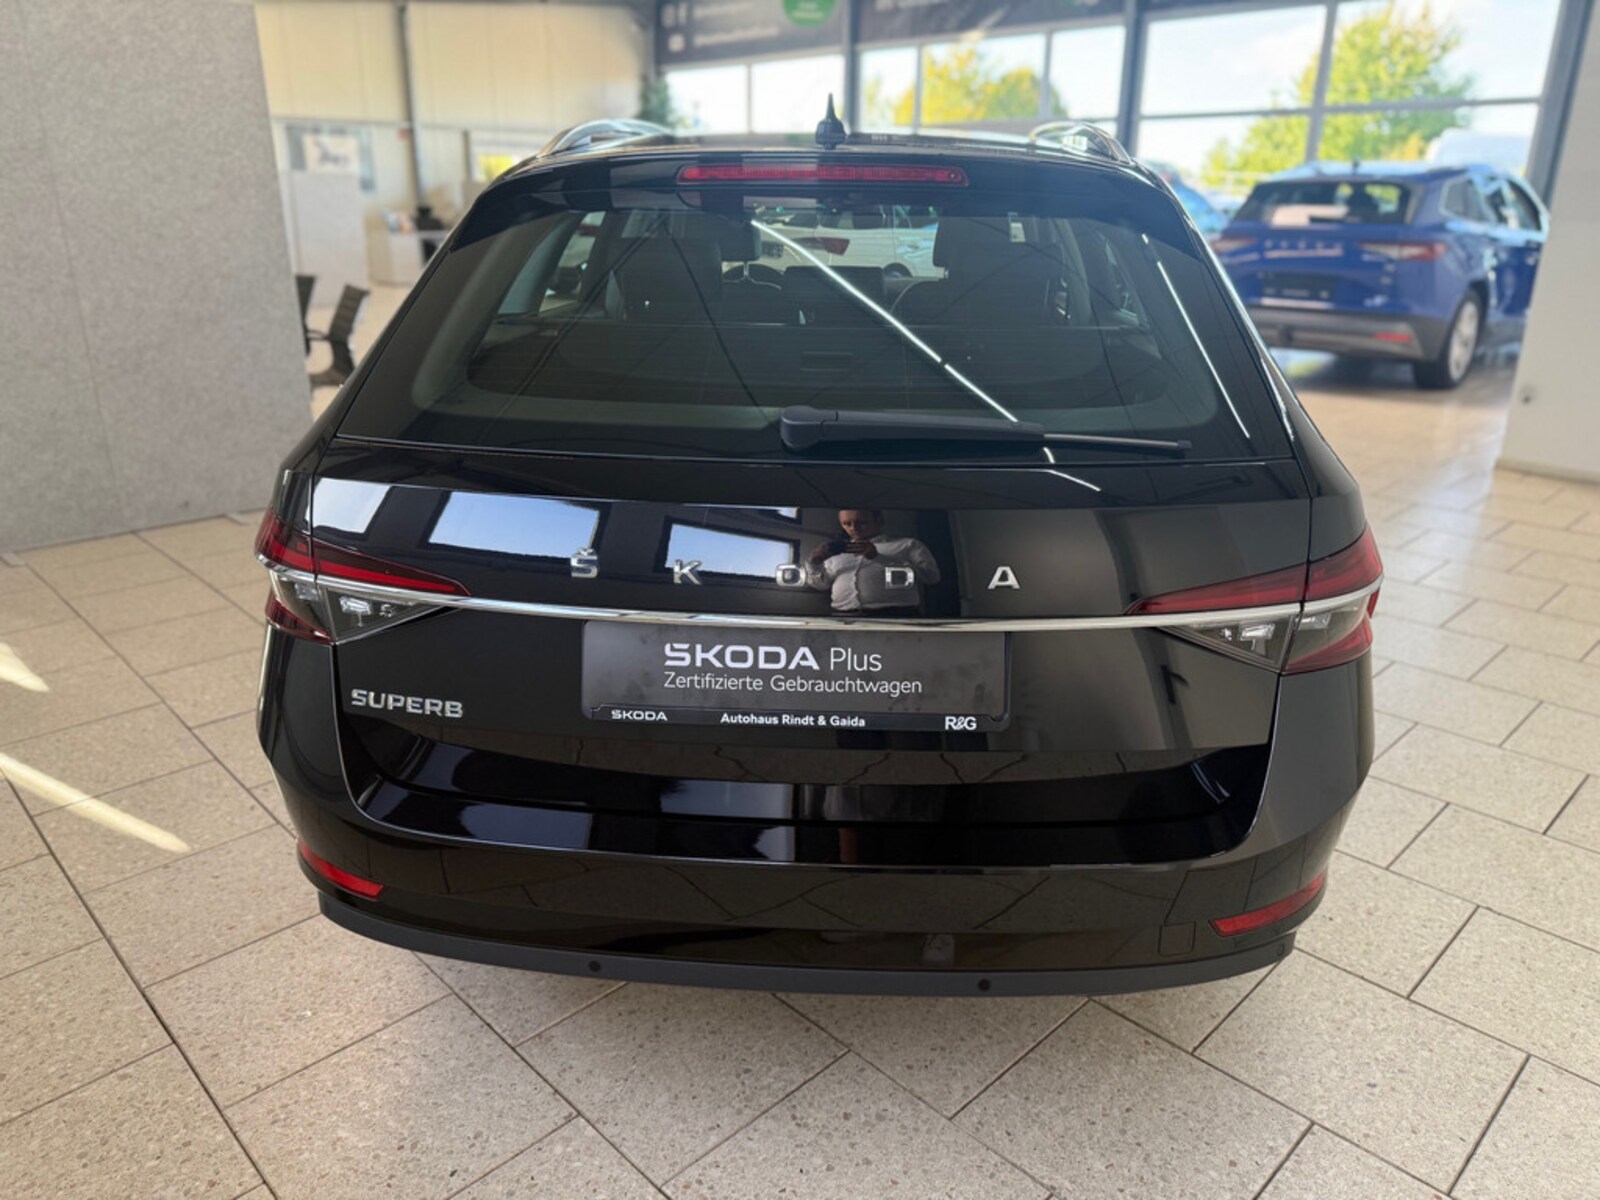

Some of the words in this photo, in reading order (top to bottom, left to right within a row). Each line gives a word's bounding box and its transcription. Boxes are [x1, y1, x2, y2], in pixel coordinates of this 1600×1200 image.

[830, 646, 882, 672] Plus
[663, 671, 764, 691] Zertifizierte
[770, 674, 922, 698] Gebrauchtwagen
[351, 688, 463, 718] SUPERB
[720, 713, 779, 725] Autohaus
[782, 714, 815, 726] Rindt
[817, 715, 826, 726] &
[829, 715, 866, 727] Gaida
[944, 716, 977, 731] R&G
